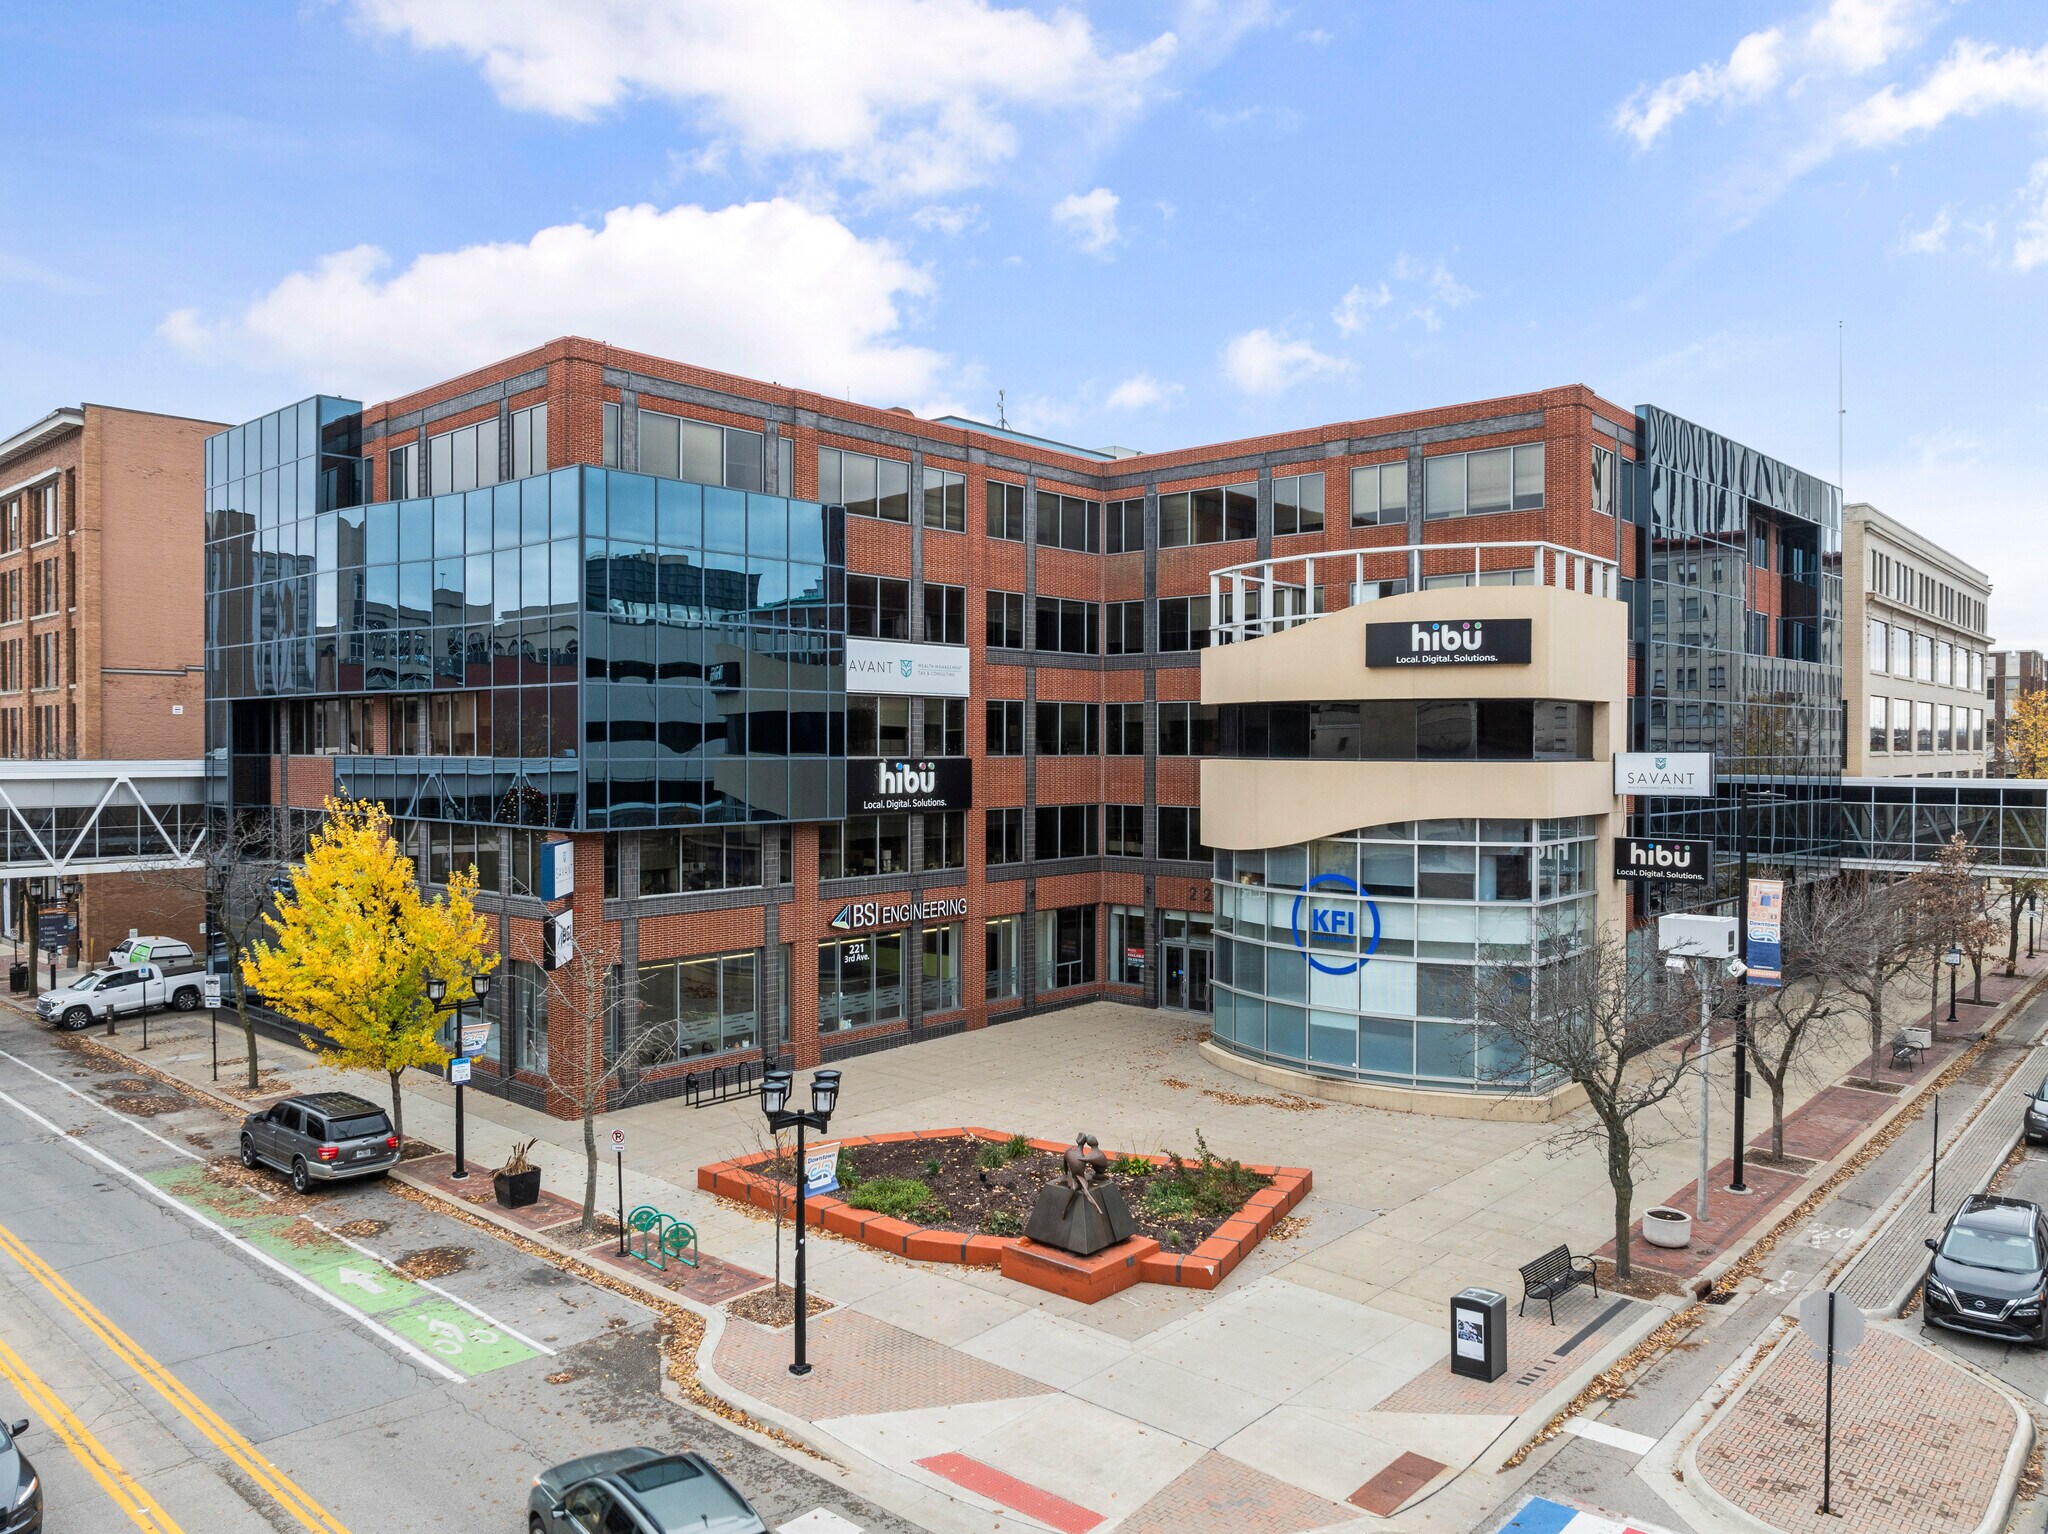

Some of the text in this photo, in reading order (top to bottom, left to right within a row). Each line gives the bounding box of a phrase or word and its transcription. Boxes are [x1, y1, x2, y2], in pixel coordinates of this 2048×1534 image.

[1411, 622, 1482, 651] hibü
[1396, 653, 1498, 665] Local. Digital. Solutions.
[848, 660, 893, 673] AVANT
[879, 761, 936, 794] hibü
[1627, 772, 1695, 785] SAVANT
[863, 798, 947, 810] Local. Digital. Solutions.
[1630, 842, 1690, 867] hibü
[1616, 868, 1705, 880] Local. Digital. Solutions.
[1189, 886, 1211, 902] 22
[853, 898, 967, 928] BSI ENGINEERING
[1312, 908, 1355, 935] KFI
[1749, 920, 1779, 928] Downtown
[849, 943, 864, 954] 221
[844, 953, 870, 963] 3rd Ave.
[807, 1152, 836, 1164] Downtown
